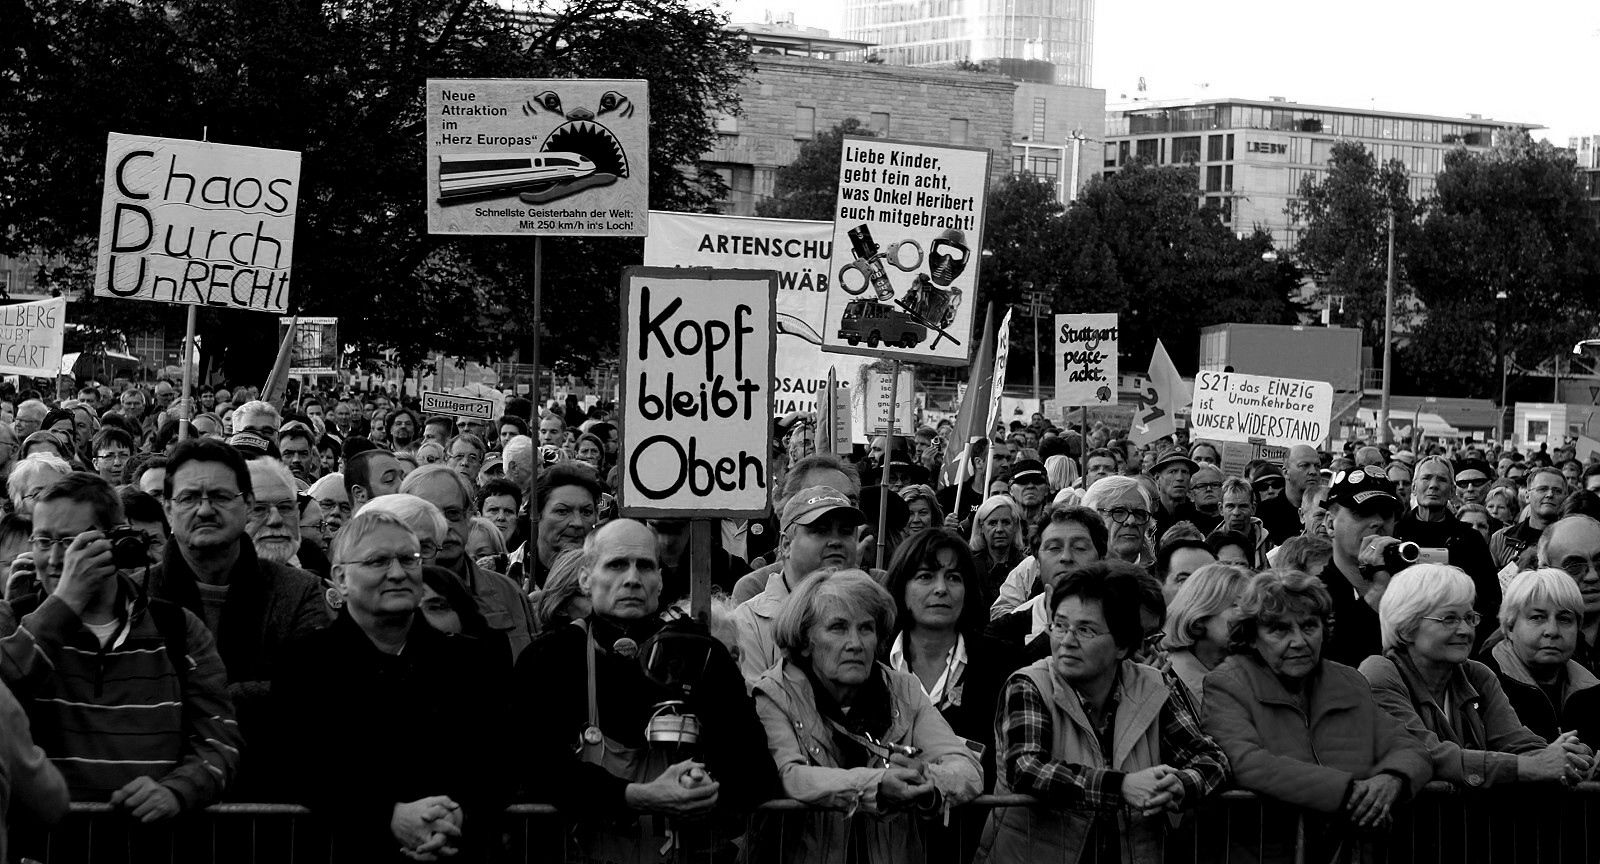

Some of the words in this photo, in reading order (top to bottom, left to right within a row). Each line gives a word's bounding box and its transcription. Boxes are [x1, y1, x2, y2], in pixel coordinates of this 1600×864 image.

[442, 91, 476, 101] Neue
[442, 105, 507, 116] Attraktion
[442, 120, 457, 130] im
[846, 146, 885, 165] Liebe
[890, 150, 941, 172] Kinder,
[116, 150, 292, 213] Chaos
[844, 167, 877, 183] gebt
[882, 169, 910, 186] fein
[915, 174, 951, 192] acht,
[842, 187, 870, 202] was
[874, 187, 913, 206] Onkel
[916, 191, 974, 212] Heribert
[475, 208, 525, 218] Schnellste
[528, 208, 587, 218] Geisterbahn
[590, 209, 606, 218] der
[609, 209, 634, 219] Welt:
[840, 205, 875, 222] euch
[878, 208, 975, 231] mitgebracht!
[111, 203, 281, 268] Durch
[519, 221, 534, 230] Mit
[537, 221, 555, 230] 250
[558, 220, 584, 230] km/h
[606, 221, 634, 230] Loch!
[698, 234, 832, 260] ARTENSCHU
[0, 305, 56, 329] LBERG
[639, 286, 754, 382] Kopf
[1059, 324, 1118, 351] Stuttgart
[1064, 350, 1108, 371] peace-
[1069, 363, 1107, 382] ackt.
[638, 371, 760, 421] bleibt
[775, 377, 849, 394] SAURS
[1239, 380, 1260, 394] das
[427, 397, 474, 412] Stuttgart
[476, 404, 489, 414] 21
[1200, 397, 1214, 411] ist
[1197, 413, 1235, 431] UNSER
[629, 434, 766, 500] Oben
